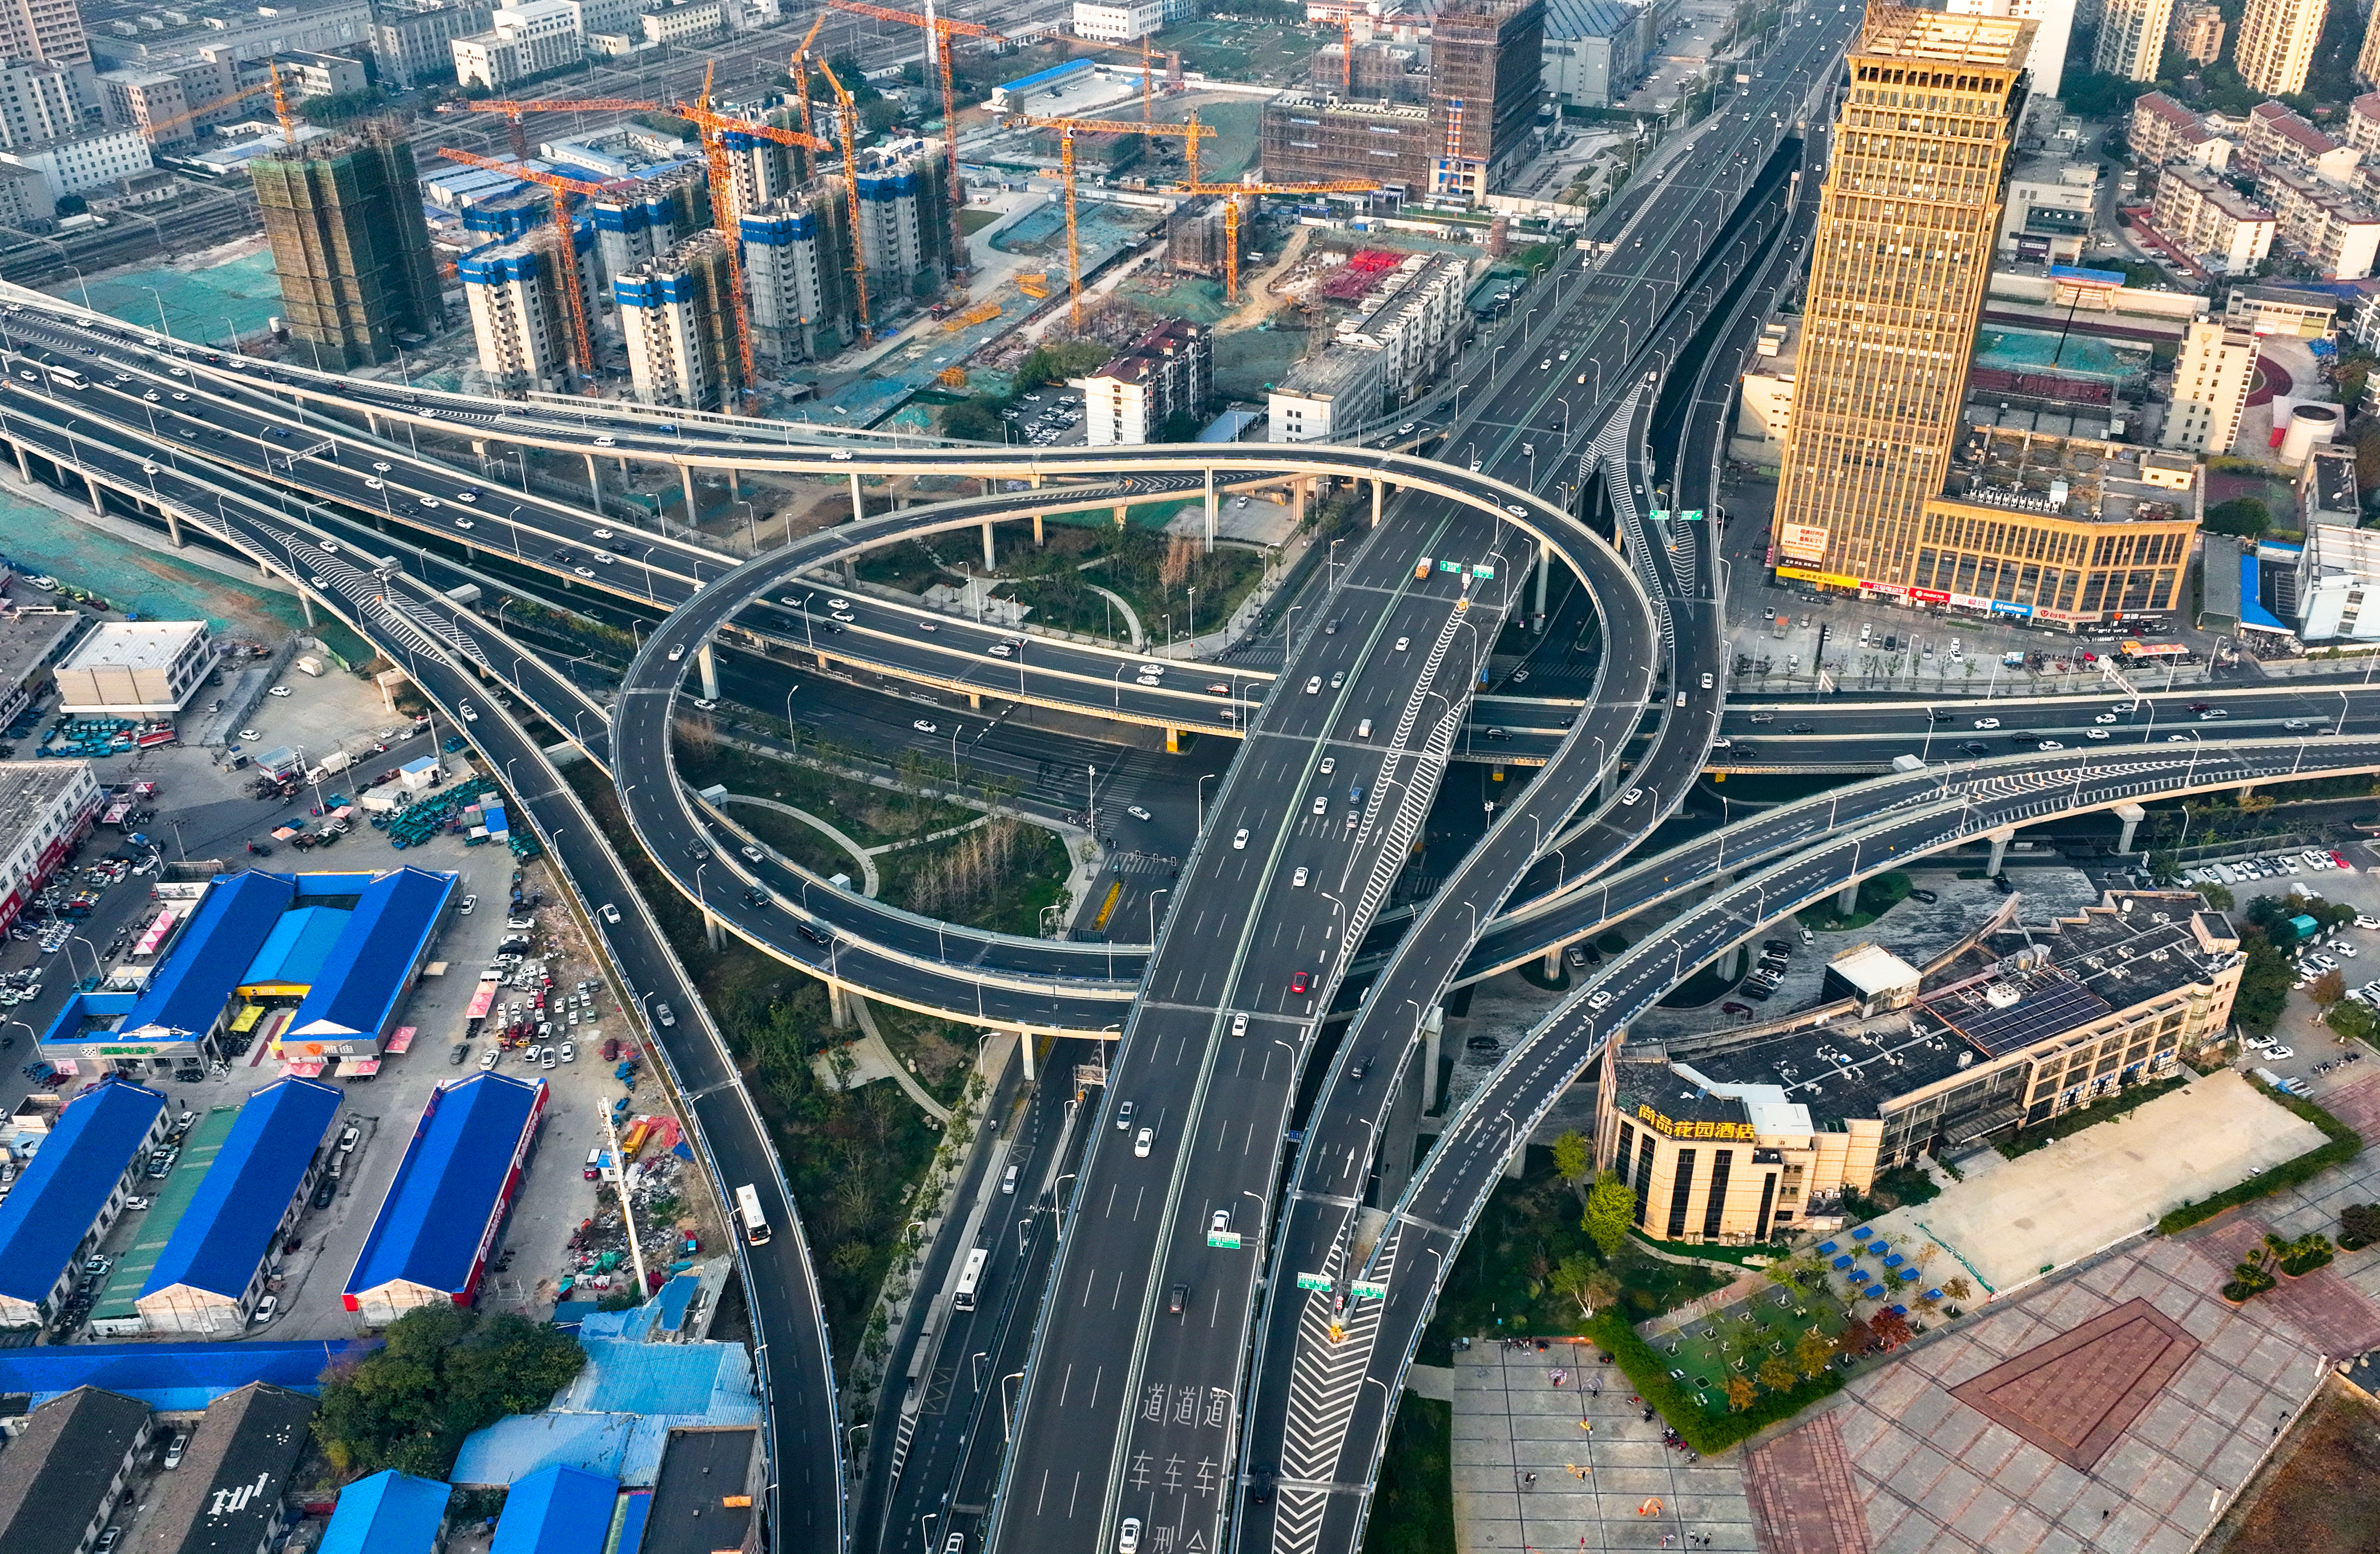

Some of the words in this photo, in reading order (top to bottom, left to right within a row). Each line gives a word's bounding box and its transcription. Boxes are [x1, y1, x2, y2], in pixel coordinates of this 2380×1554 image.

[1873, 584, 1905, 594] 立马电动车
[323, 1044, 354, 1054] 雅迪
[1638, 1104, 1756, 1139] 尚品花园酒店
